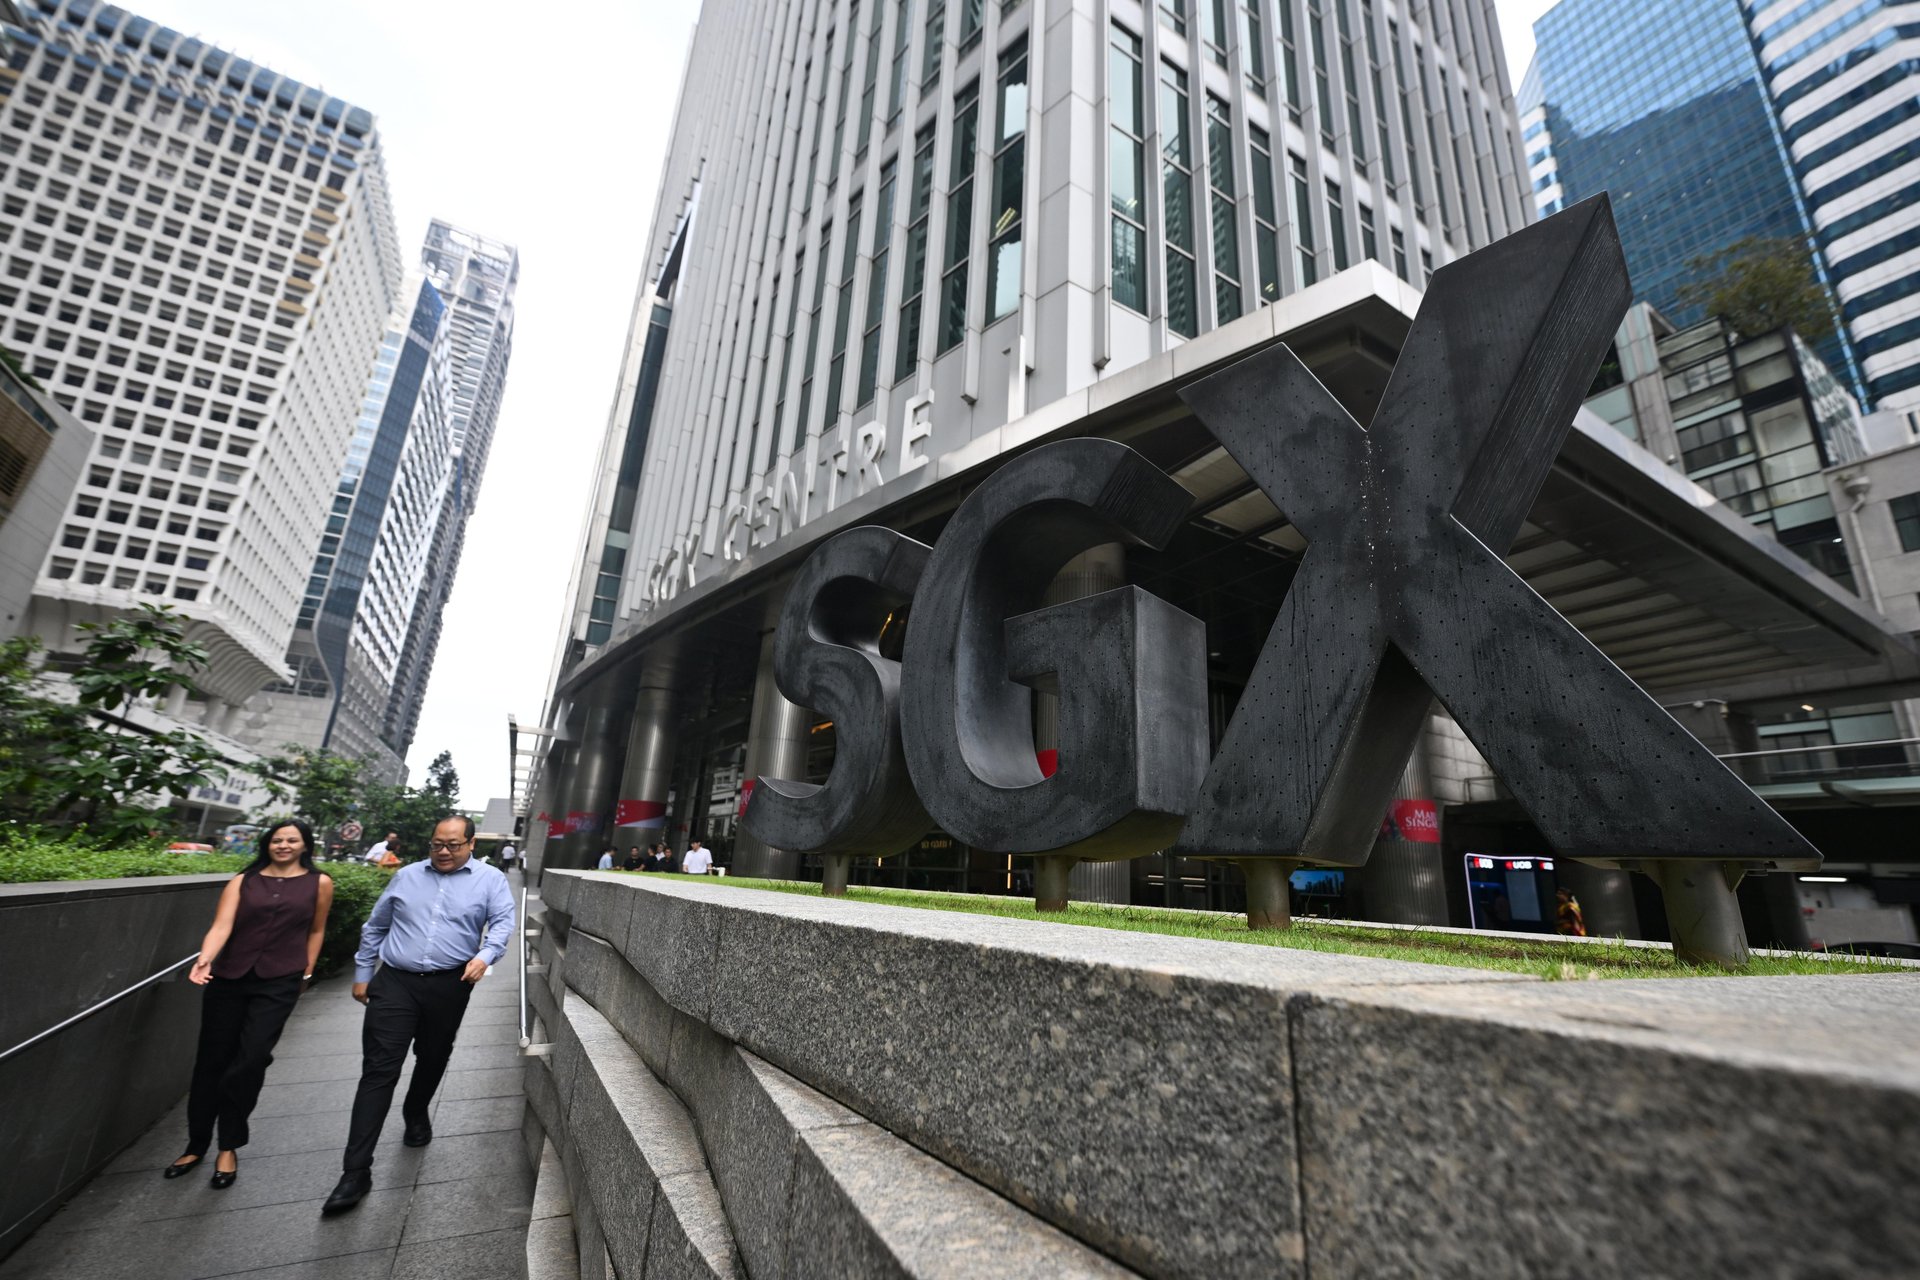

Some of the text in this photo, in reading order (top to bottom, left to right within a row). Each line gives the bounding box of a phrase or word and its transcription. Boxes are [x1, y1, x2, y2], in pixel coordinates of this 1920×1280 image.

[648, 533, 700, 611] SGX
[723, 388, 935, 561] CENTRE
[741, 191, 1824, 865] SGX
[1512, 861, 1532, 869] UOB
